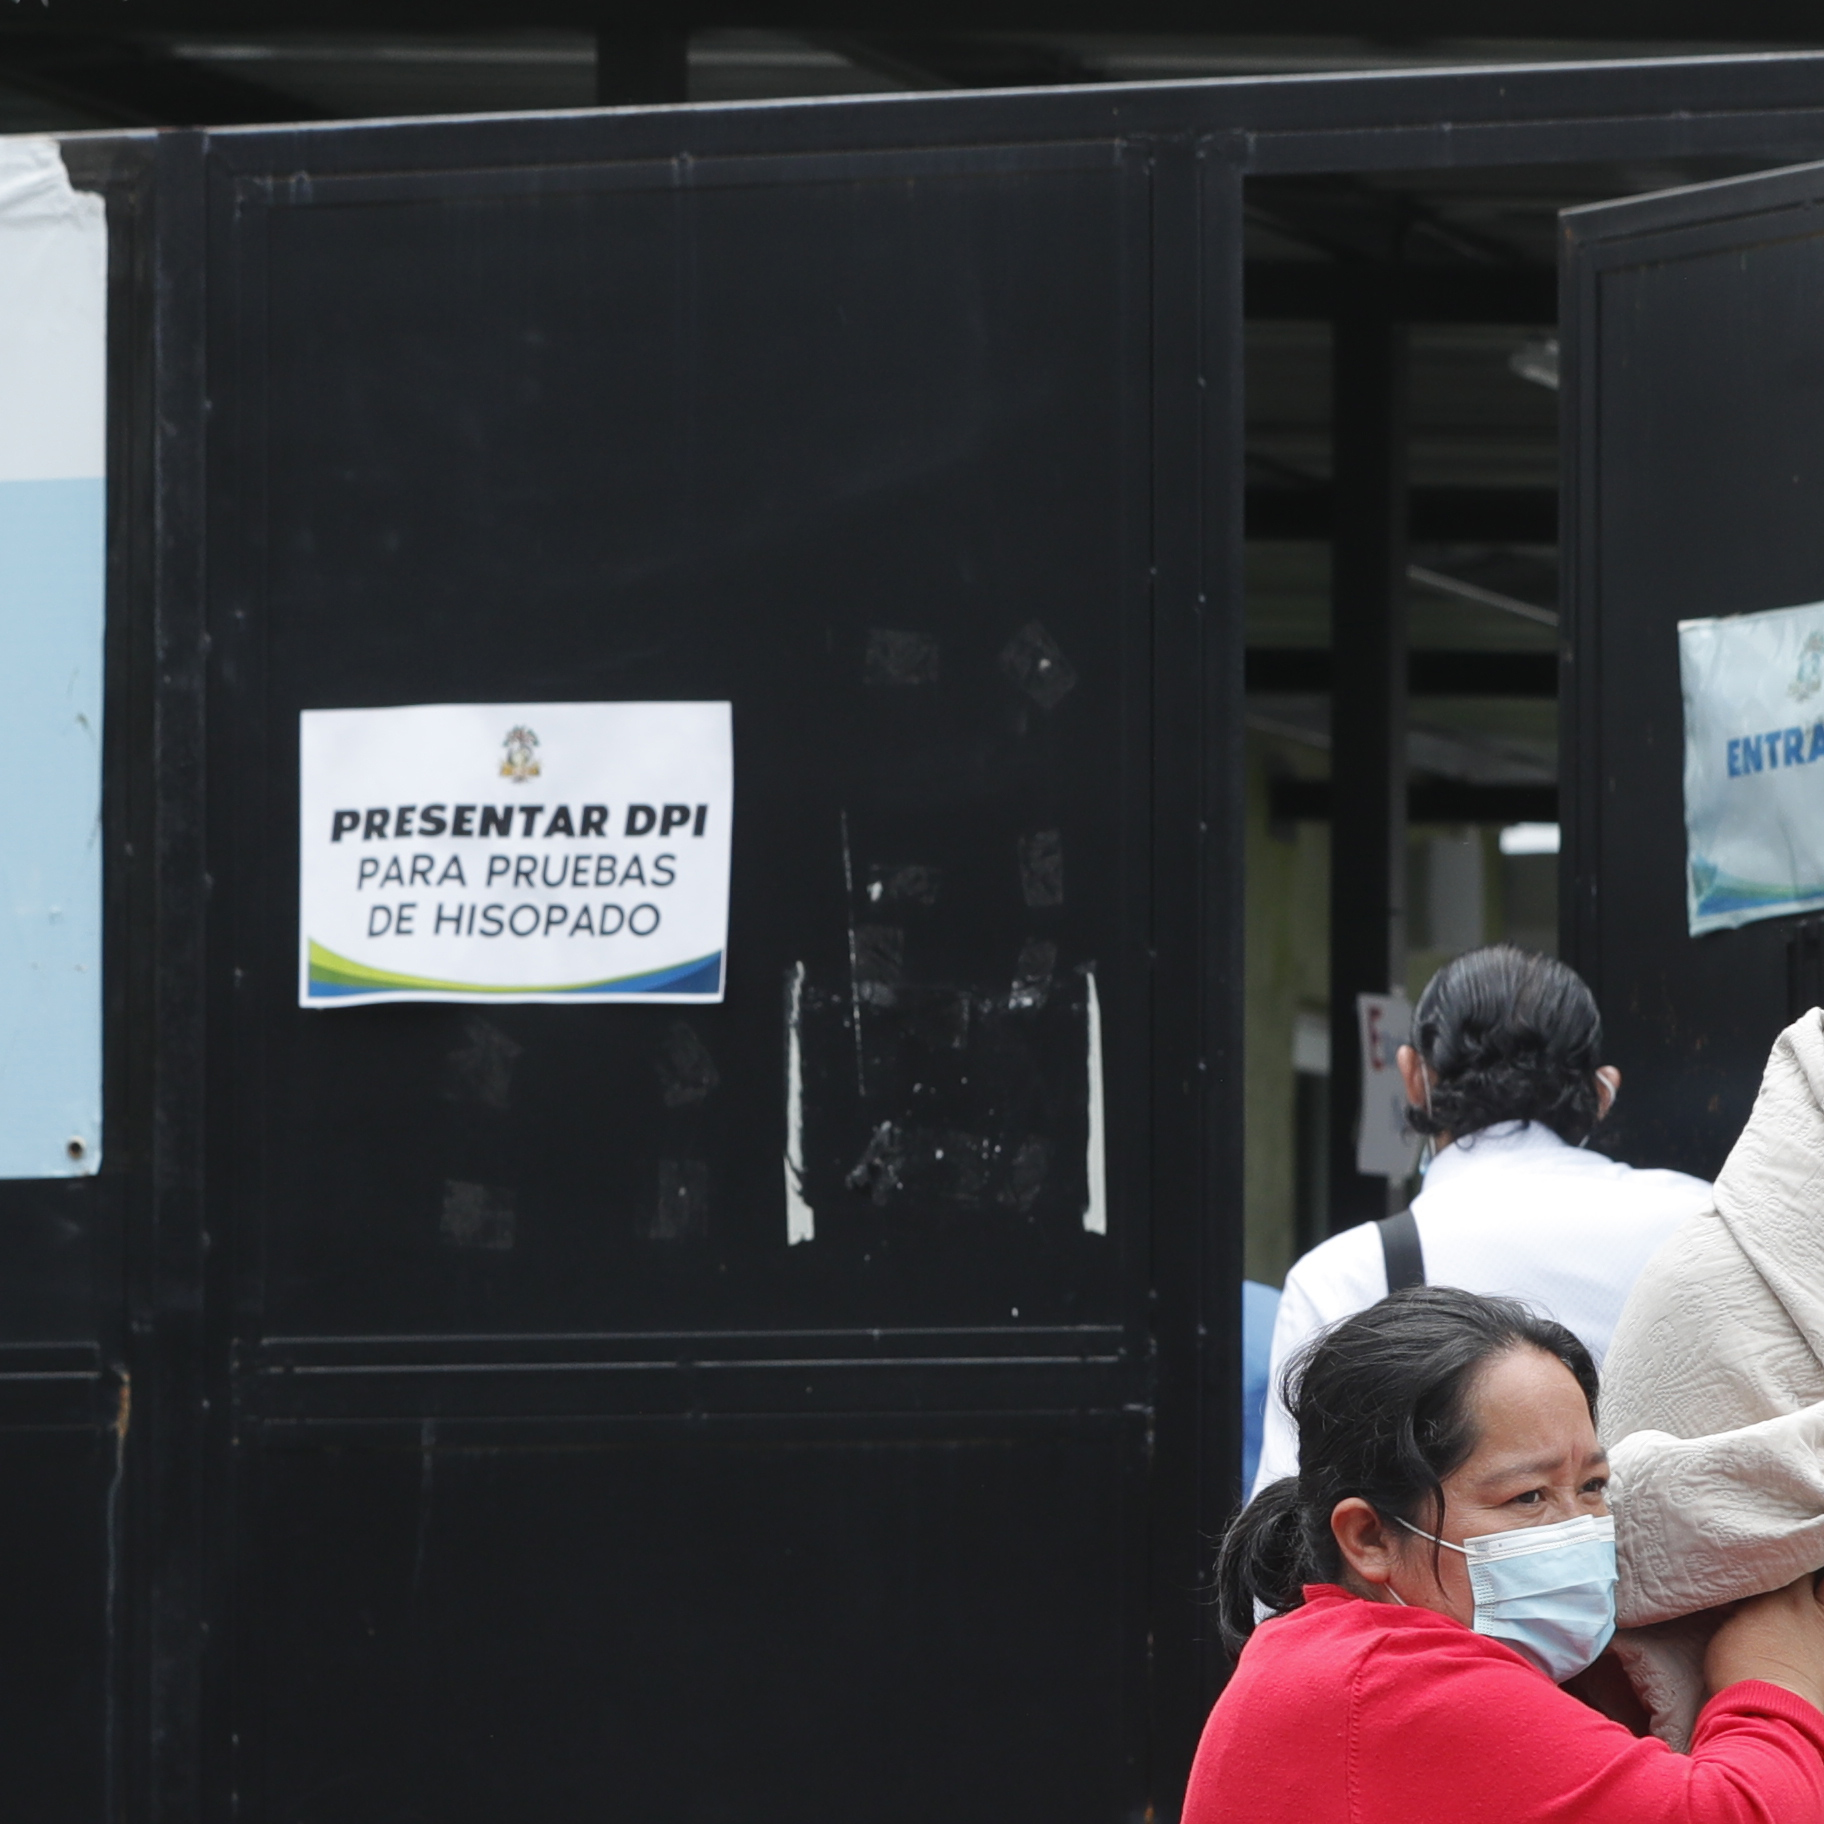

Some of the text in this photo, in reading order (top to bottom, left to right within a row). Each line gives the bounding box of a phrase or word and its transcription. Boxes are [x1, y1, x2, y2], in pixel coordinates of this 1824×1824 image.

[330, 803, 709, 843] PRESENTAR DPI
[357, 854, 677, 891] PARA PRUEBAS
[367, 903, 662, 938] DE HISOPADO
